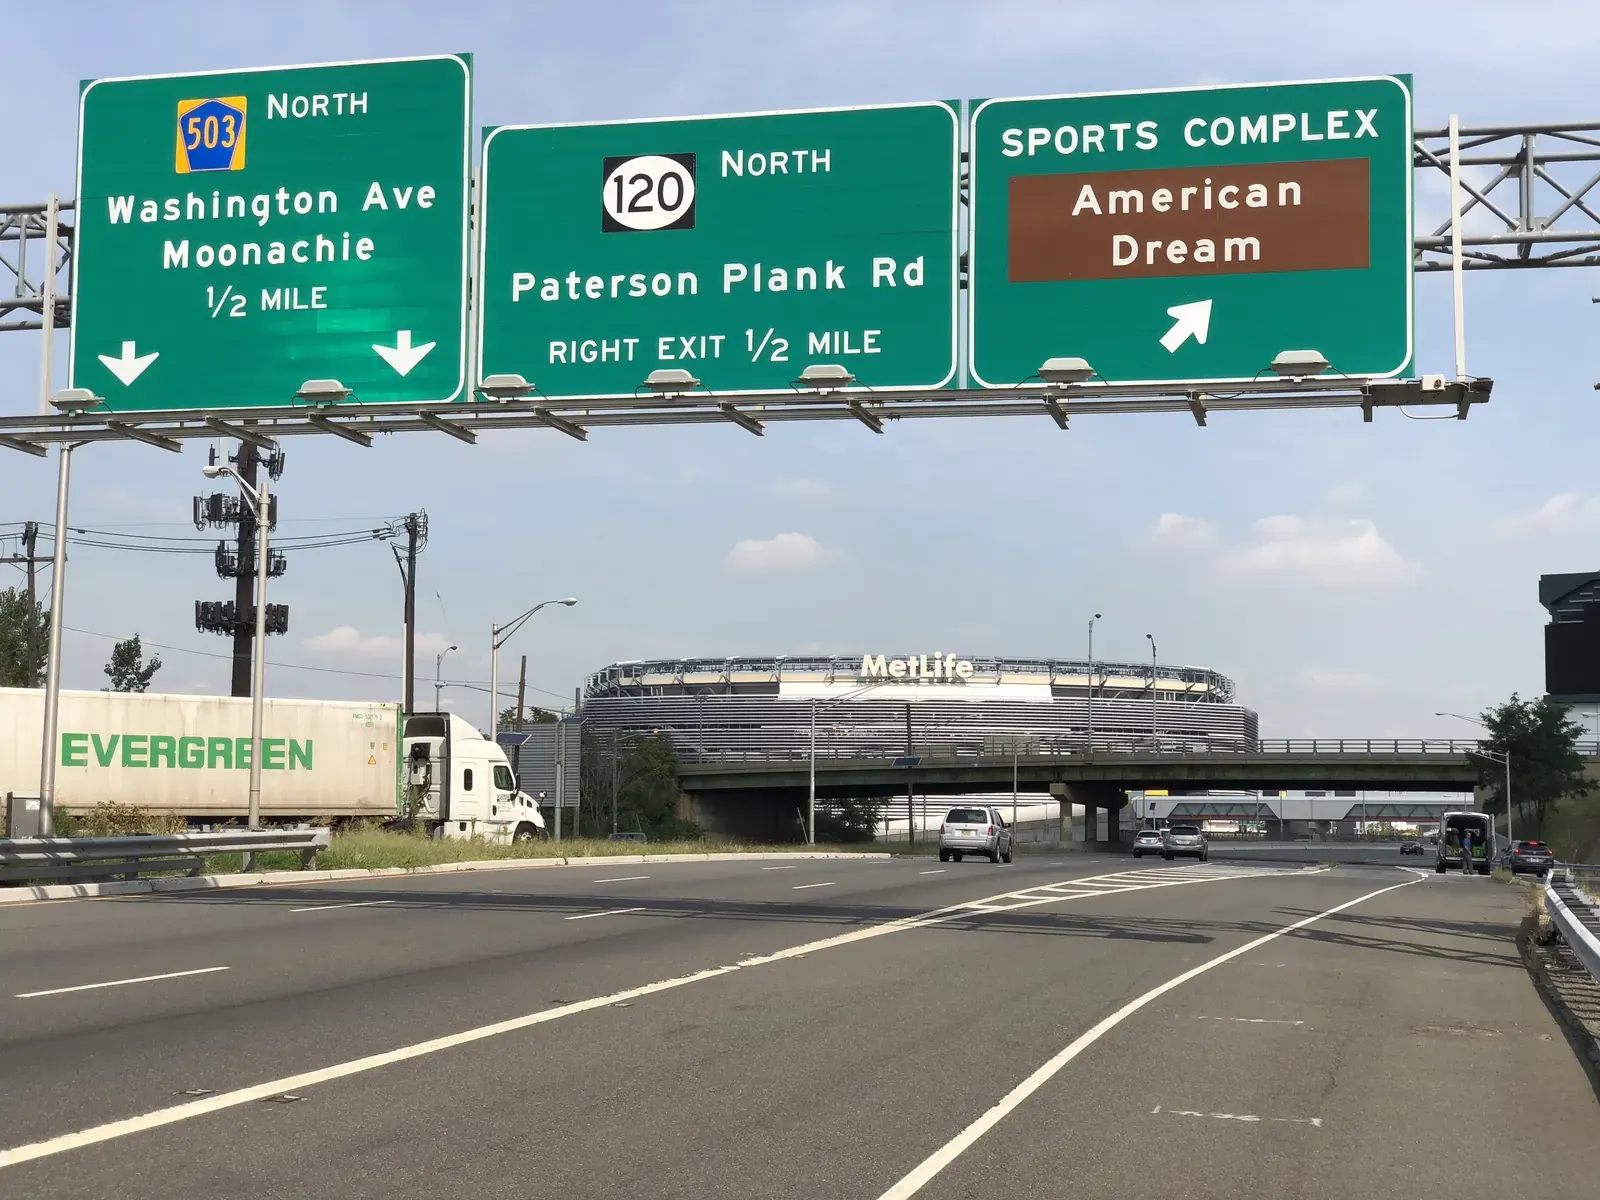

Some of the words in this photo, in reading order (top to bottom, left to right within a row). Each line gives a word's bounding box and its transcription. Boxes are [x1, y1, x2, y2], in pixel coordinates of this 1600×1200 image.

[268, 92, 367, 119] NORTH
[187, 114, 236, 150] 503
[1002, 121, 1157, 157] SPORTS
[1184, 109, 1378, 147] COMPLEX
[722, 149, 830, 177] NORTH
[108, 187, 337, 226] Washington
[362, 182, 435, 210] Ave
[613, 171, 685, 214] 120
[1072, 178, 1301, 216] American
[164, 232, 374, 268] Moonachie
[1113, 235, 1260, 266] Dream
[513, 271, 697, 301] Paterson
[724, 260, 845, 293] Plank
[873, 256, 923, 287] Rd
[262, 287, 326, 310] MILE
[550, 339, 639, 363] RIGHT
[659, 336, 725, 359] EXIT
[809, 330, 880, 354] MILE
[860, 651, 974, 678] MetLife
[61, 733, 313, 770] EVERGREEN
